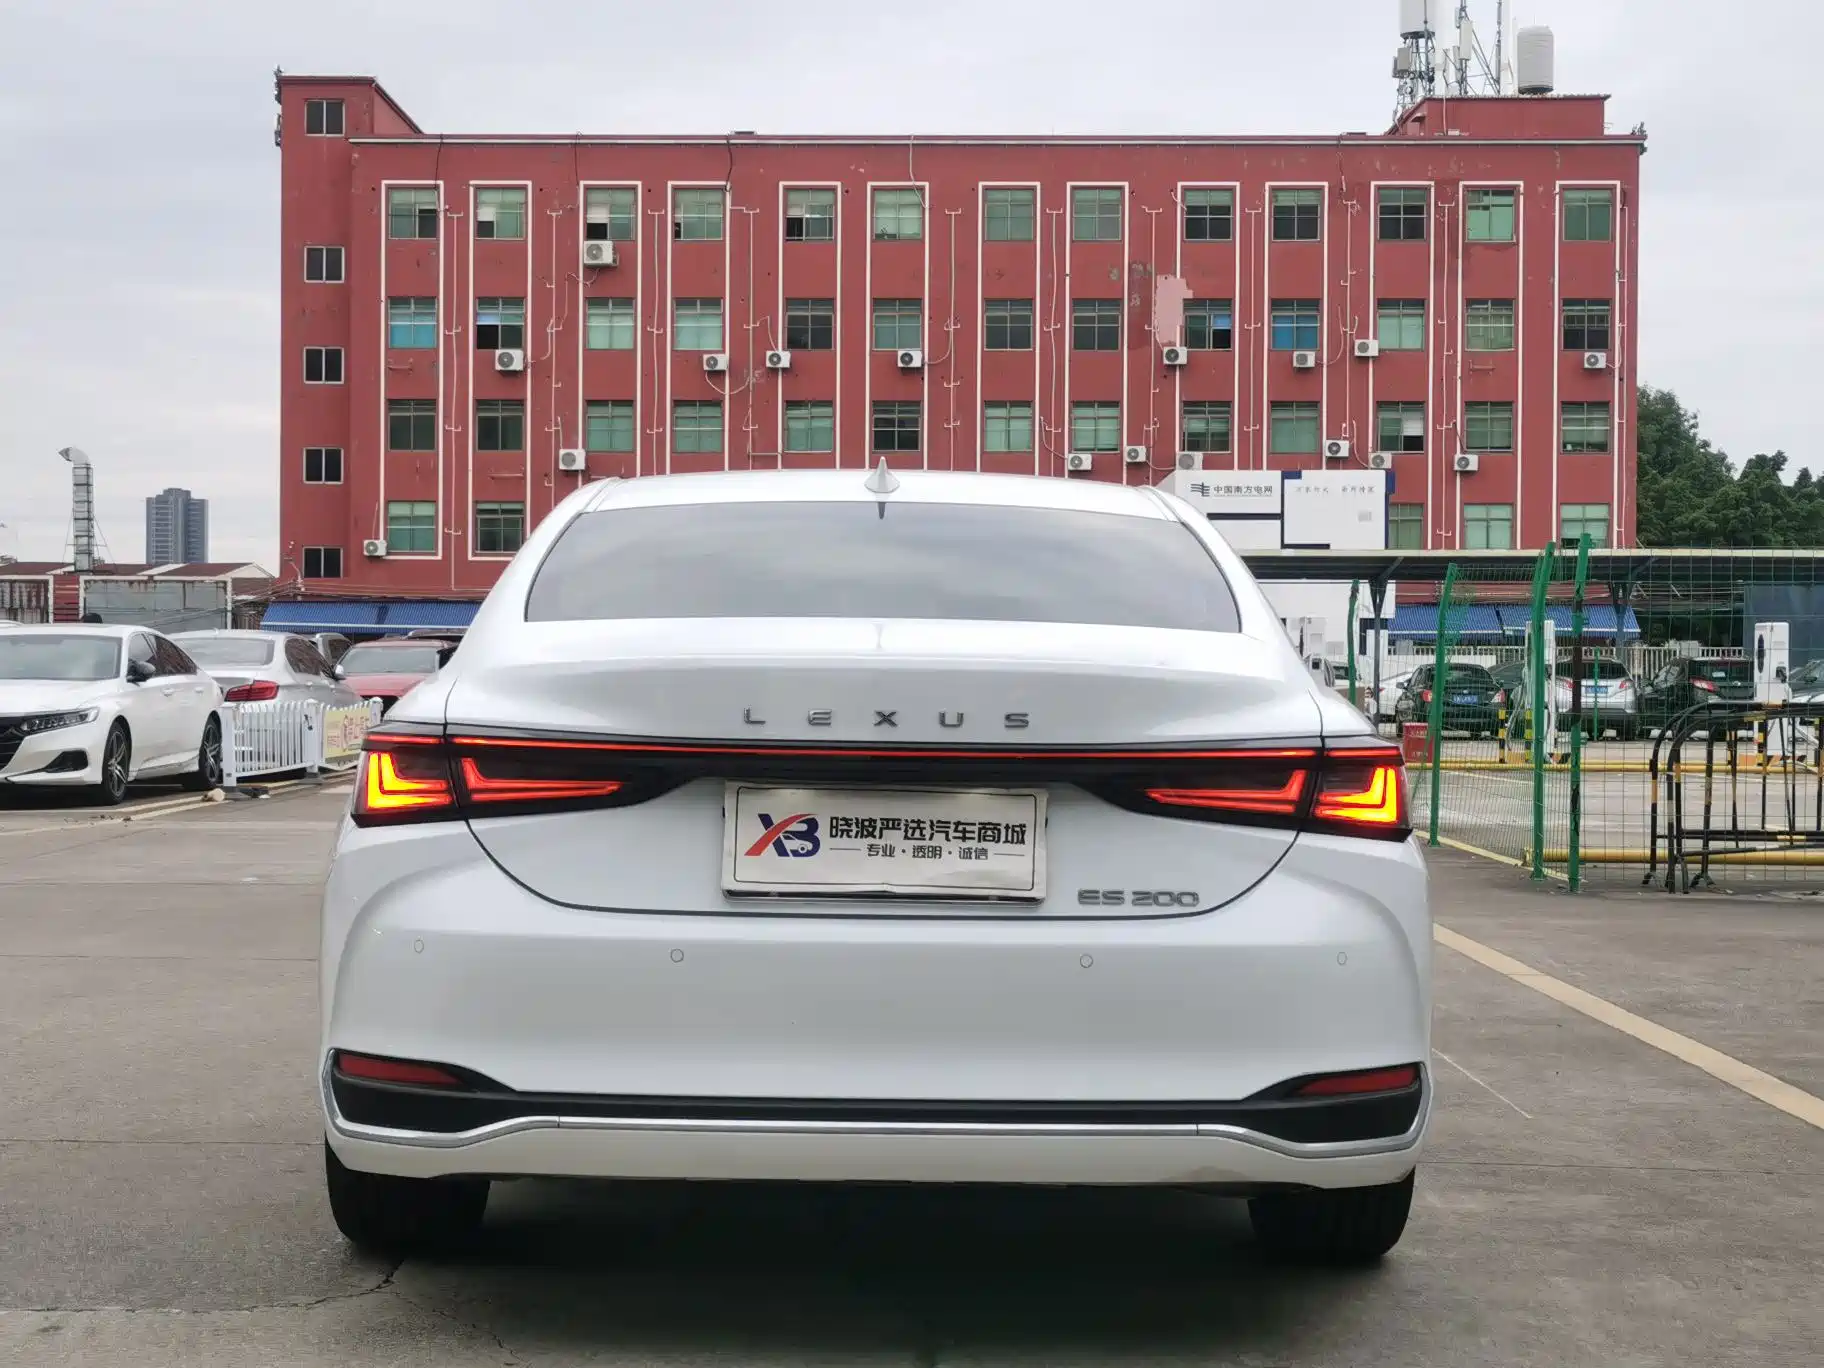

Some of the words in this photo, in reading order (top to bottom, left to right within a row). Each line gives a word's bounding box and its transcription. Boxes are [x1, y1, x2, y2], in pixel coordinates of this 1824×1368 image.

[1213, 484, 1273, 495] 中国南方电网
[743, 707, 1030, 729] LEXUS
[829, 816, 1027, 845] 晓波严选汽车商城
[1077, 888, 1125, 906] ES
[1131, 890, 1200, 907] 200
